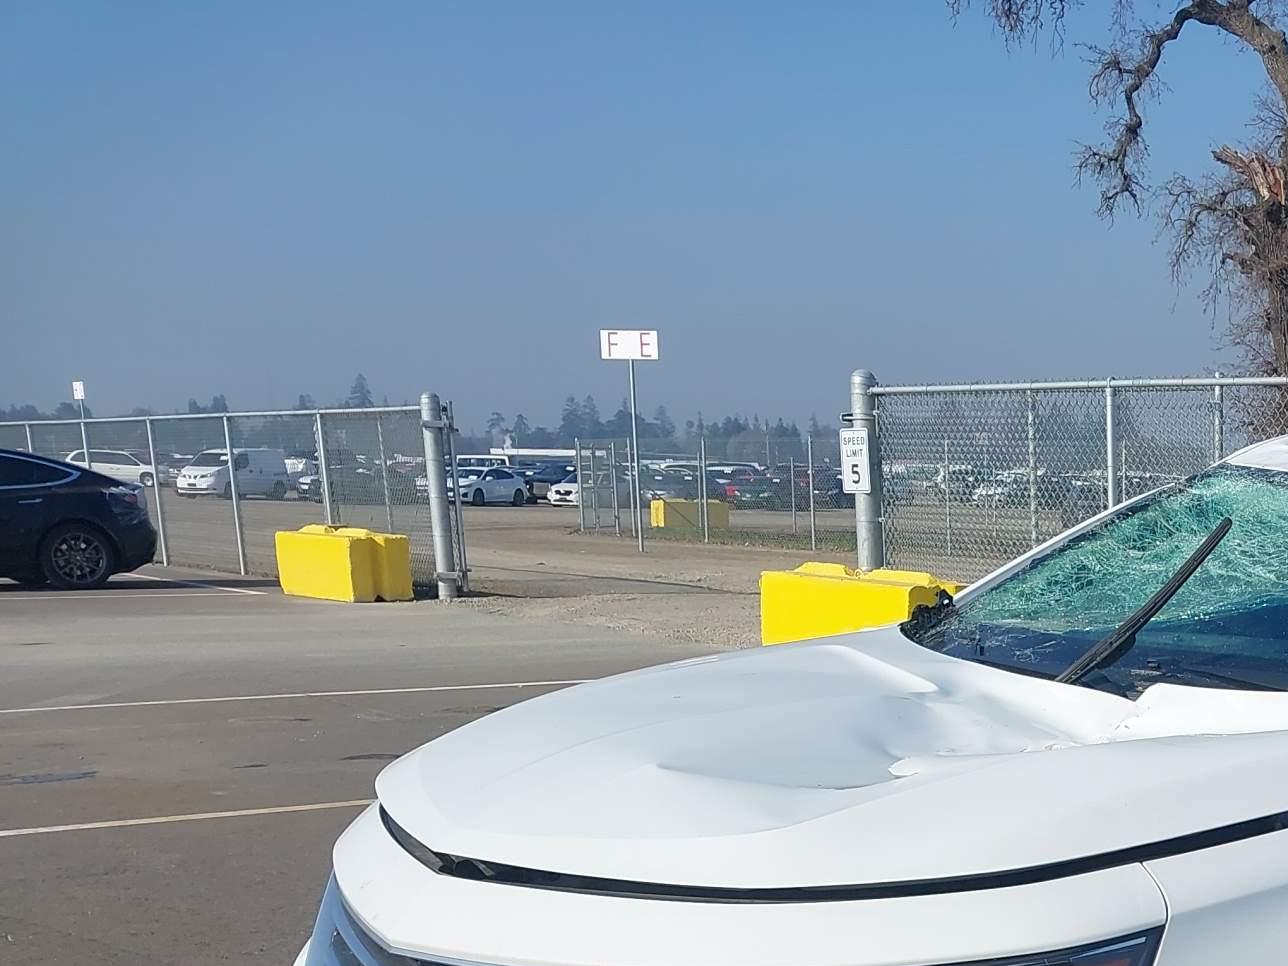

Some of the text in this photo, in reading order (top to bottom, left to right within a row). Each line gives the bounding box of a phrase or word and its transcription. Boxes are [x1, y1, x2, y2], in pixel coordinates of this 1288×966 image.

[607, 332, 652, 358] F E
[843, 436, 865, 446] SPEED
[845, 448, 864, 458] LIMIT
[851, 463, 861, 485] 5
